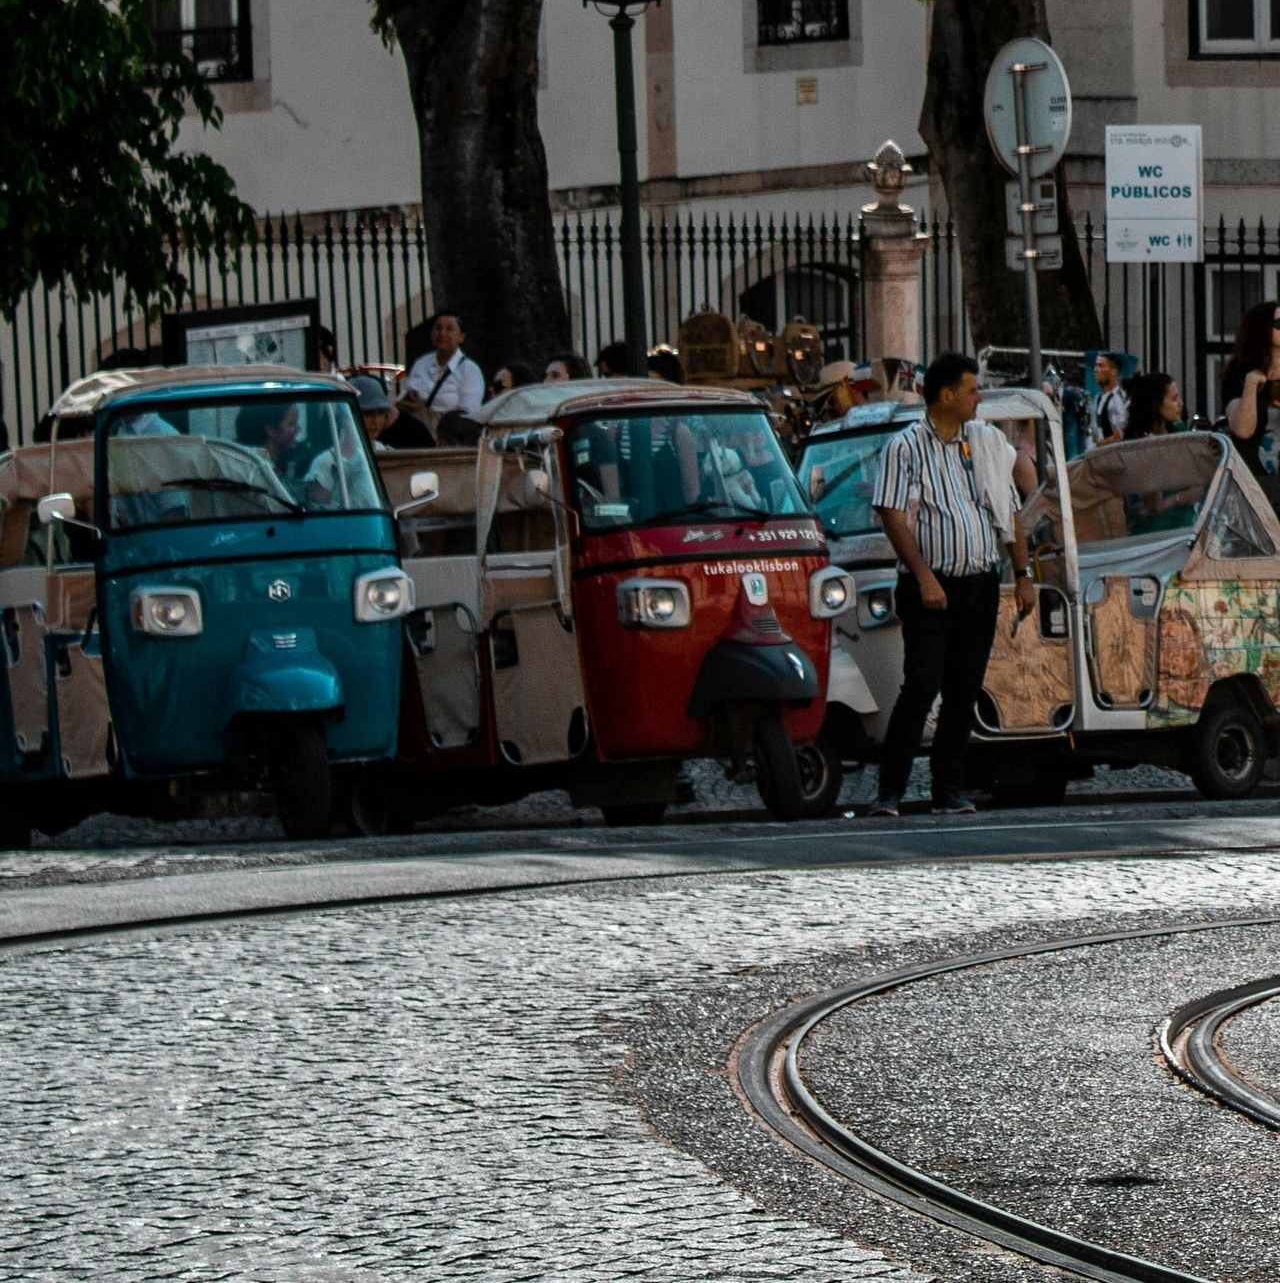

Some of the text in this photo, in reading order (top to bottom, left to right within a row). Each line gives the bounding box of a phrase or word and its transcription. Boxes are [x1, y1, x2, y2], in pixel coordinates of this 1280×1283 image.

[1138, 166, 1163, 178] WC
[1111, 183, 1192, 198] PÚBLICOS
[1148, 235, 1171, 247] WC
[757, 530, 777, 542] 351
[778, 528, 798, 541] 929
[703, 558, 799, 576] tukalooklisbon
